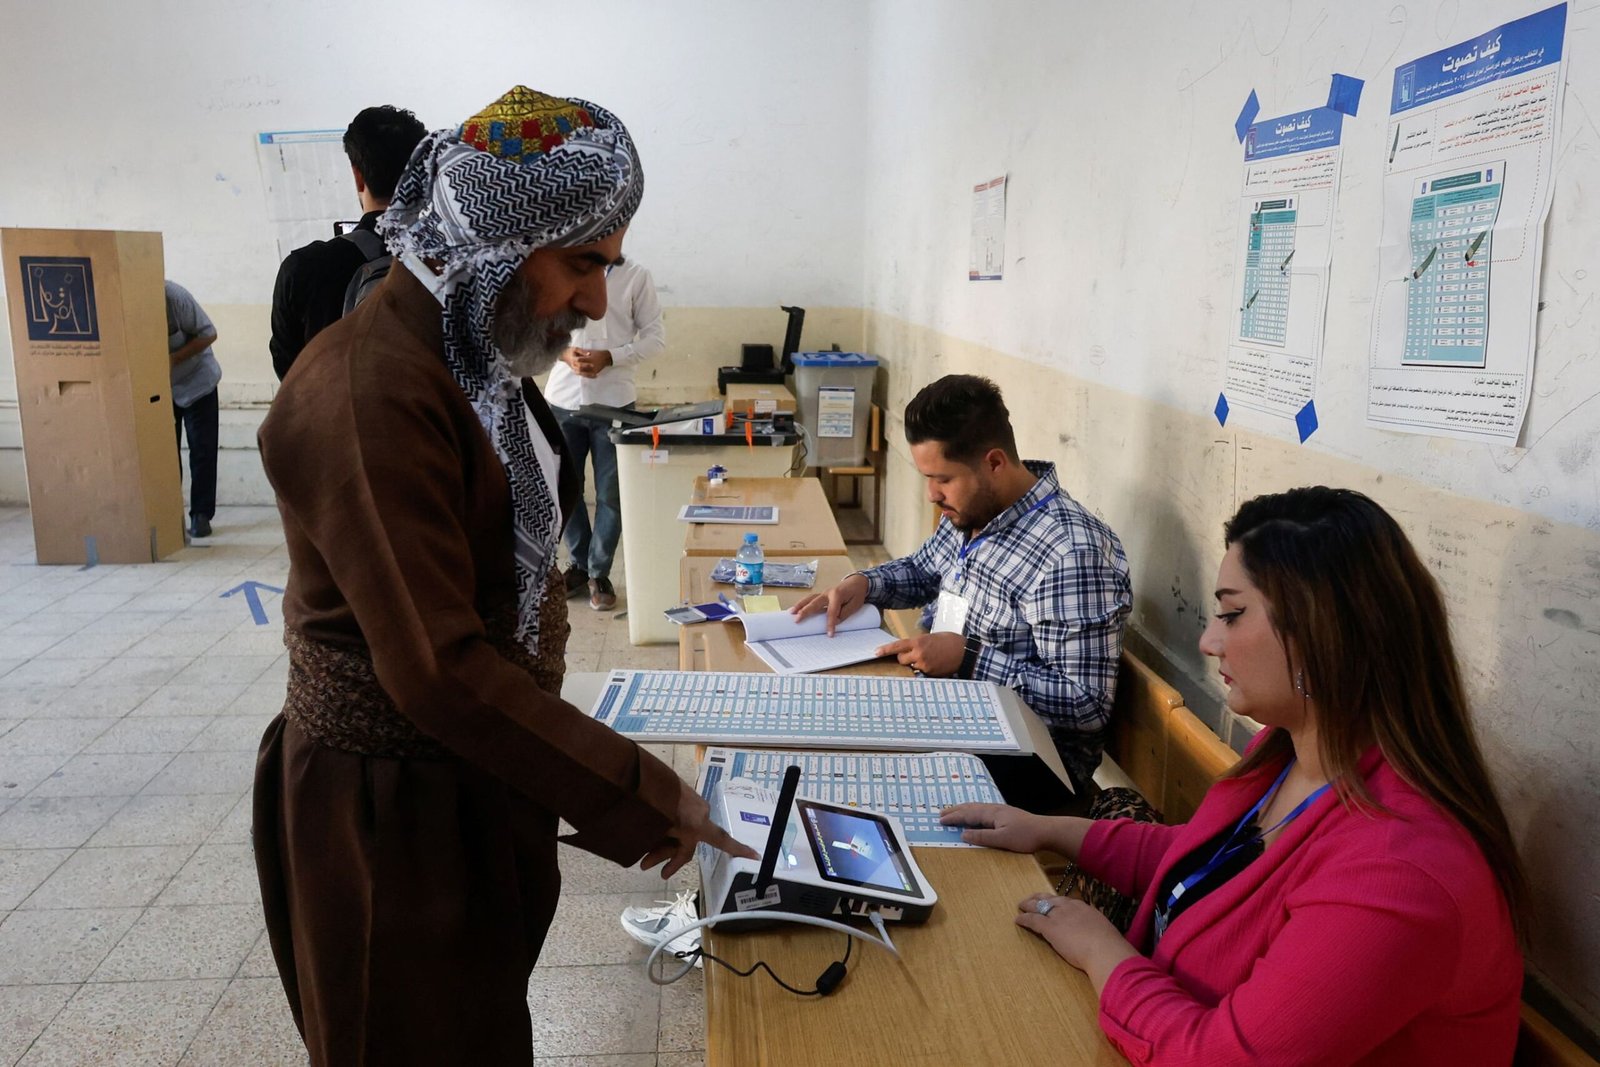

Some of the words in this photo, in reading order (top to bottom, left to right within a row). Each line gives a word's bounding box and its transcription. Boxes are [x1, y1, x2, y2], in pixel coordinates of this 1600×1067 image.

[1480, 33, 1502, 59] كيف
[1442, 45, 1477, 73] تصوت
[1275, 118, 1296, 136] تصوت
[1296, 114, 1312, 133] كيف
